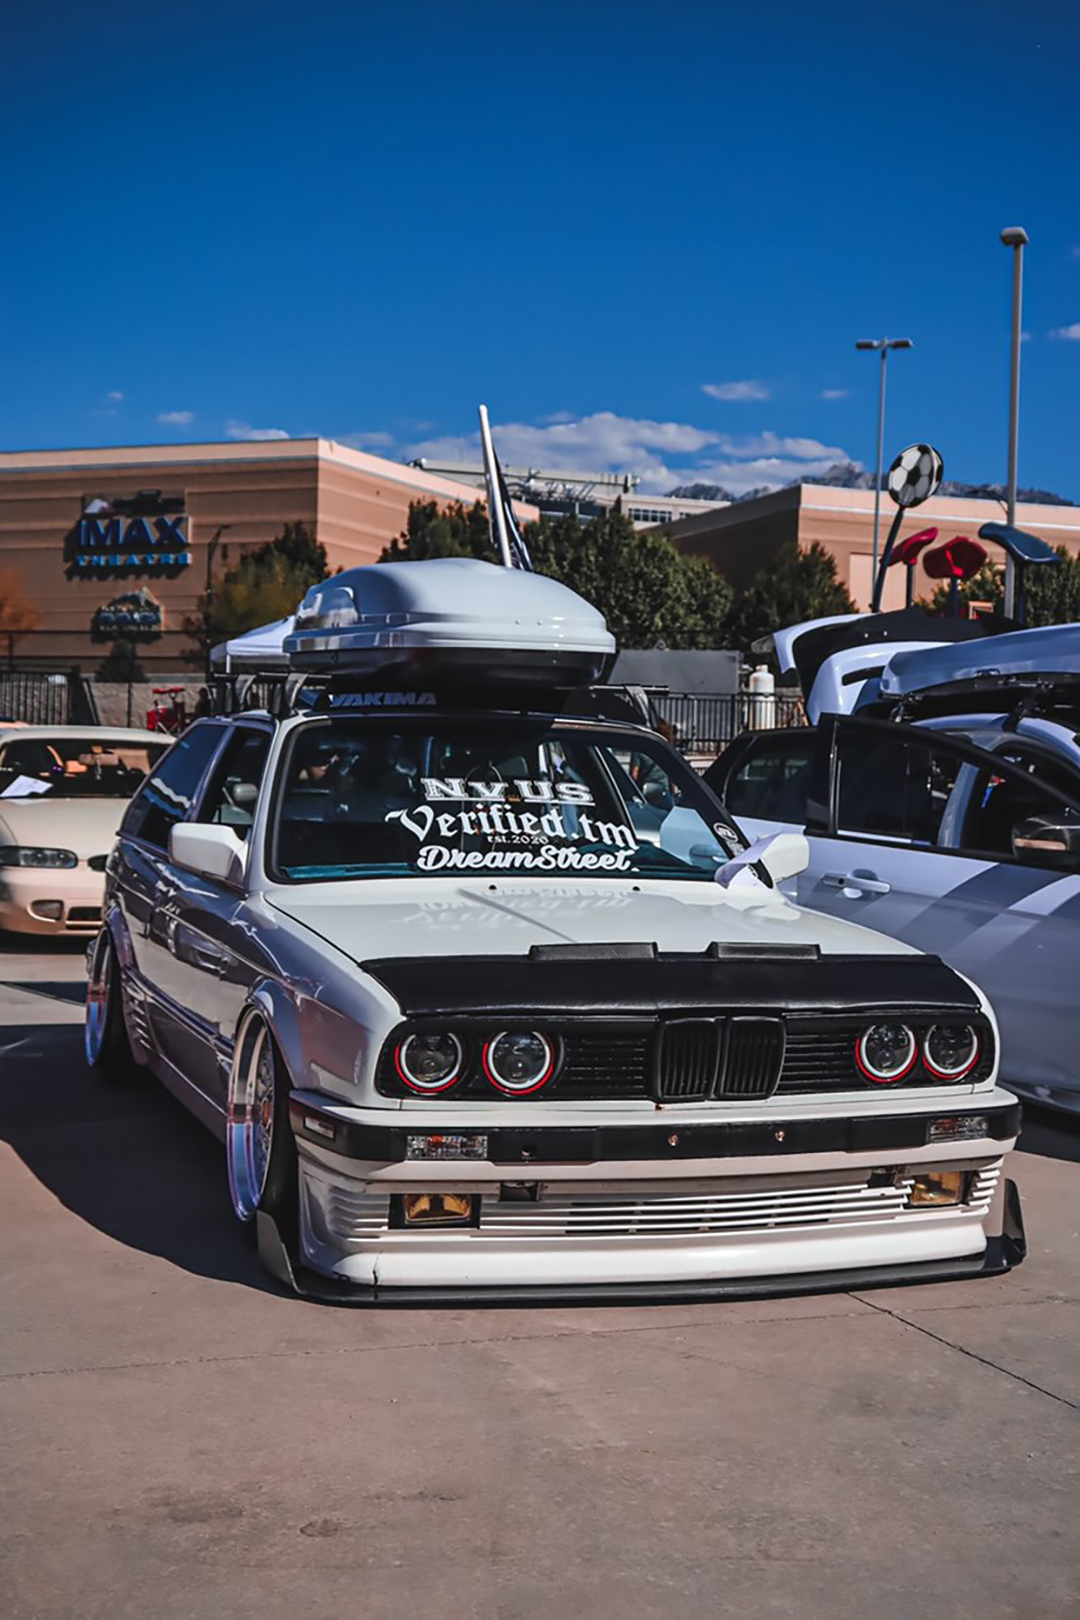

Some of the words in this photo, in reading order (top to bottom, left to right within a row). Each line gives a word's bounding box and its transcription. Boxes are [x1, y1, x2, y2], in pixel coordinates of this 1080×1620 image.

[79, 516, 190, 546] IMAX
[76, 553, 190, 566] THEATRE
[328, 692, 437, 707] YAKIMA
[385, 803, 639, 850] Verified.tm
